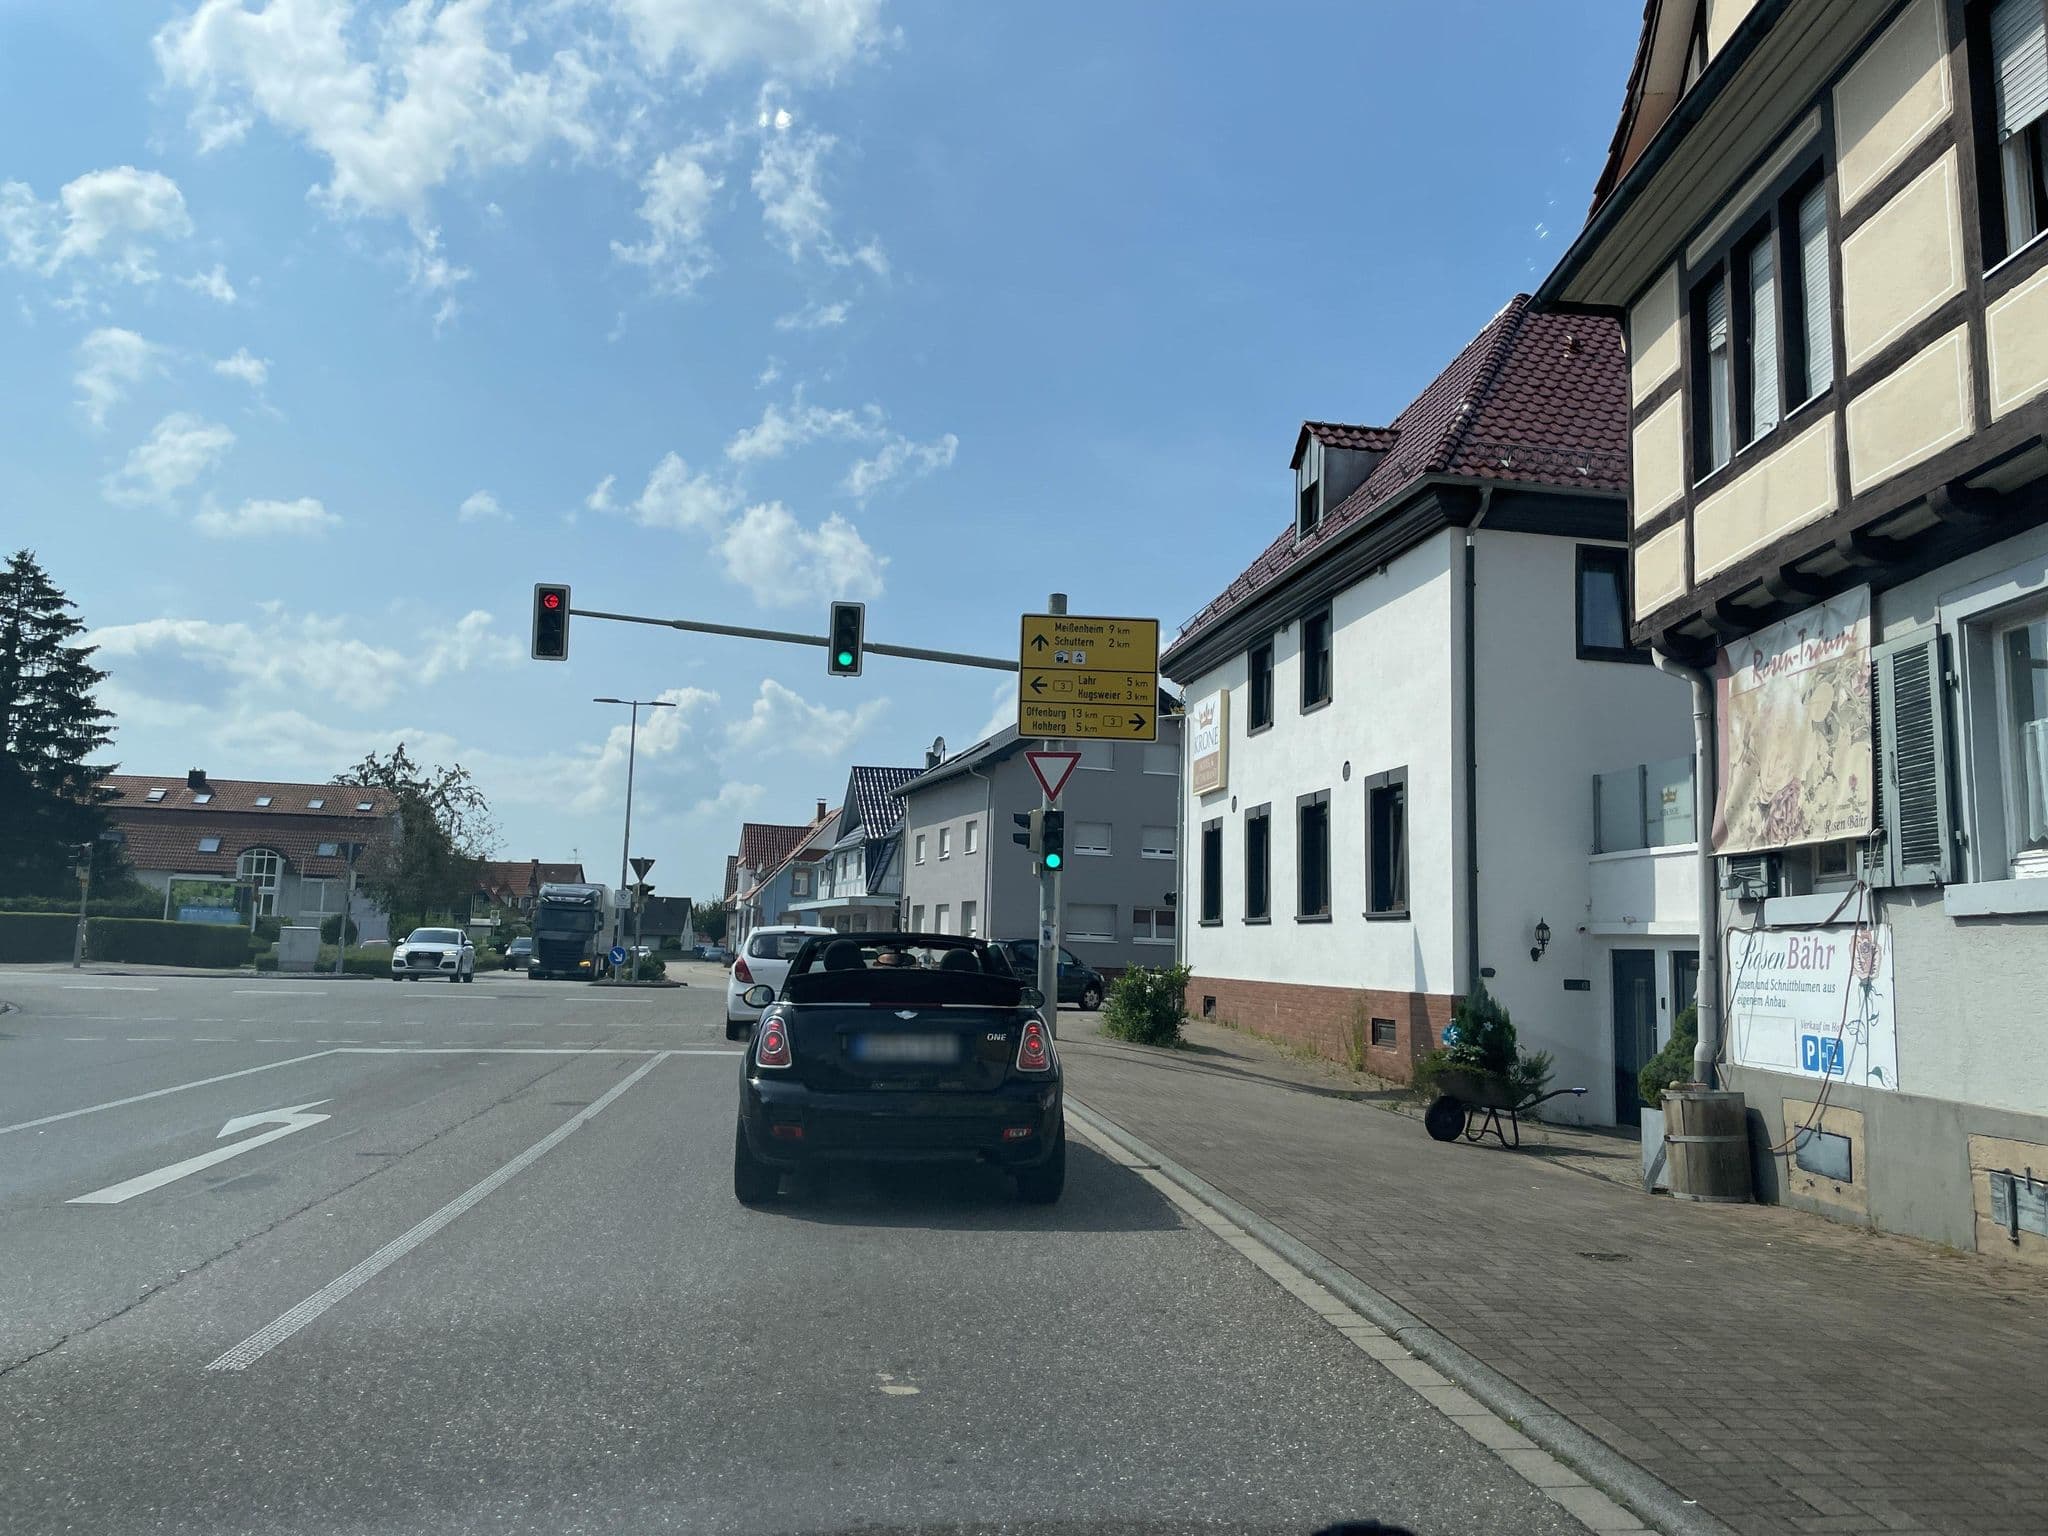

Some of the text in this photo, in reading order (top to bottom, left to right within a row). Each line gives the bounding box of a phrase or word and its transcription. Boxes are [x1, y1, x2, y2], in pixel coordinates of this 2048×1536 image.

[1055, 622, 1130, 635] Meißenheim 9 km
[1054, 636, 1130, 648] Schuttern 2 km
[1060, 682, 1066, 690] 3
[1078, 675, 1148, 688] Lahr 5 km
[1077, 689, 1148, 701] Hugsweier 3 km
[1026, 706, 1098, 719] Offenburg 13 km
[1032, 721, 1097, 734] Hohberg 5 km
[1110, 717, 1115, 725] 3
[1194, 726, 1219, 754] KRONE
[1756, 979, 1769, 991] und
[1770, 978, 1821, 993] Schnittblumen
[1822, 983, 1836, 993] aus
[1737, 994, 1786, 1008] eigenem Anbau
[1801, 1019, 1822, 1033] Verkauf
[1823, 1021, 1831, 1032] im
[986, 1033, 1007, 1041] ONE
